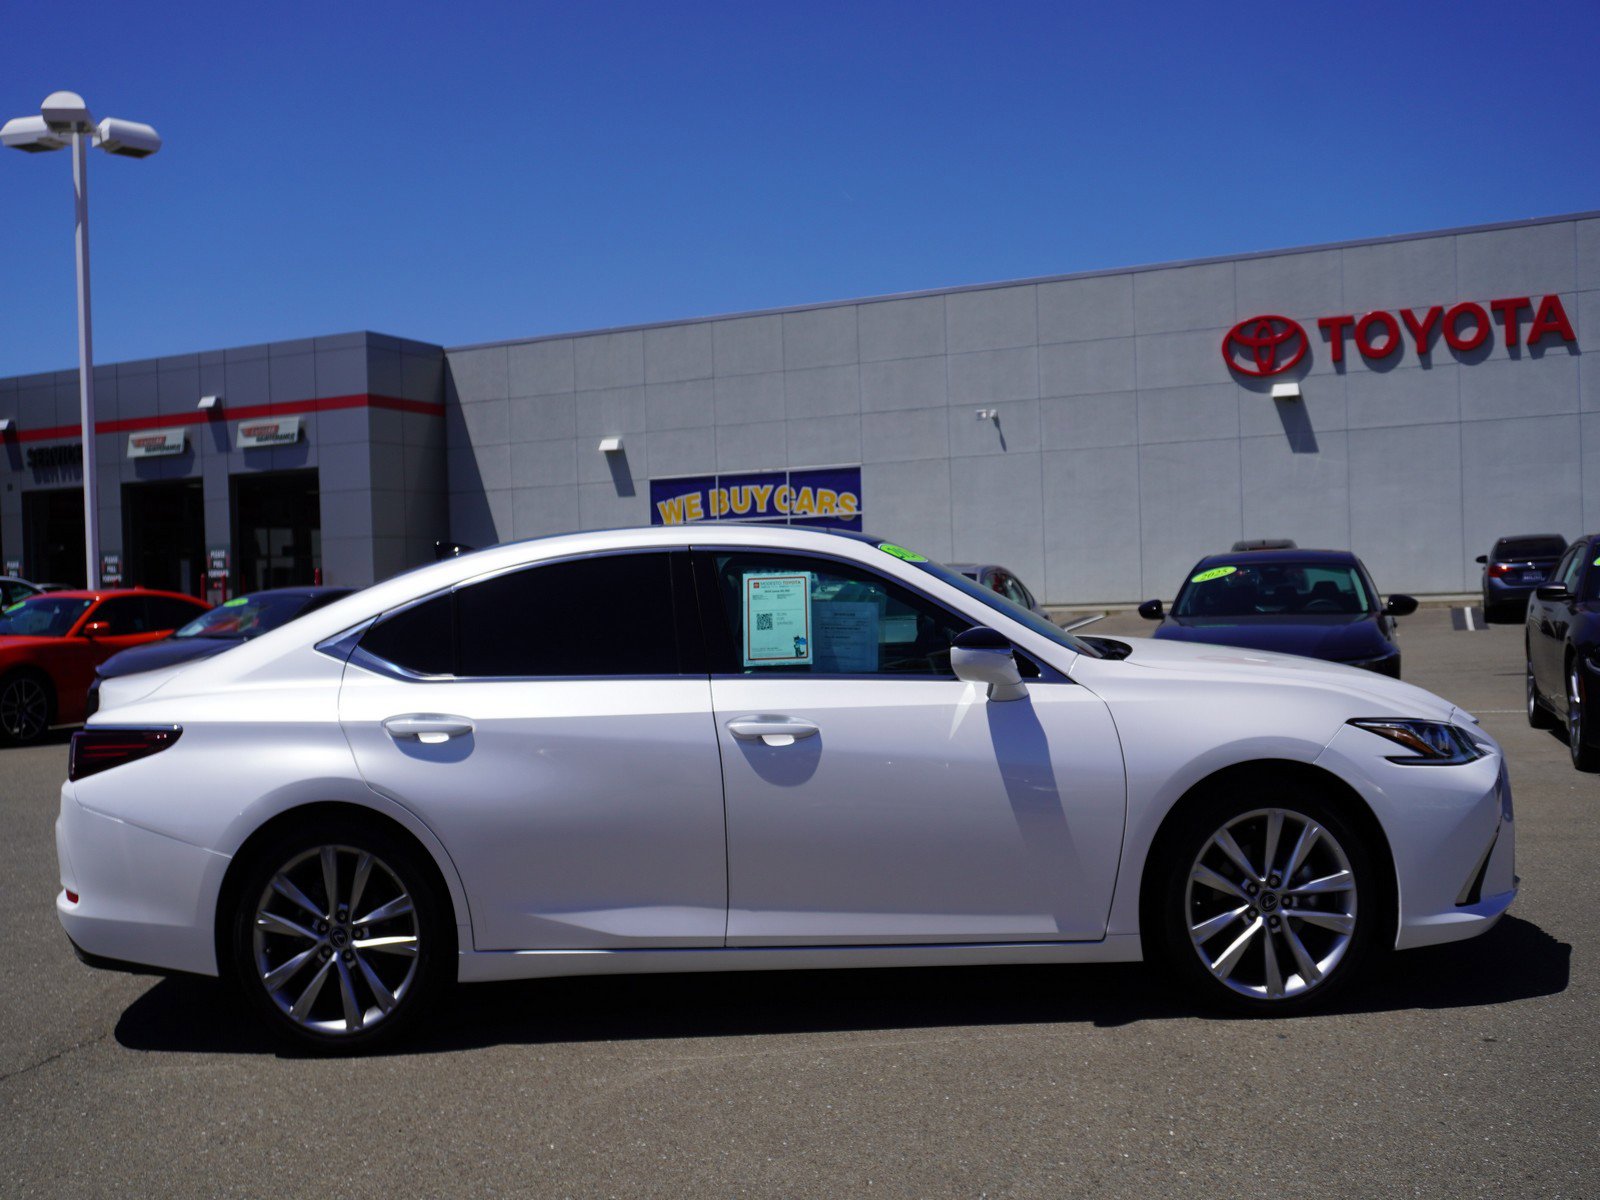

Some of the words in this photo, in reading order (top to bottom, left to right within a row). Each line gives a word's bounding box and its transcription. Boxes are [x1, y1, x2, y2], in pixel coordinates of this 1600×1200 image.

[1318, 294, 1577, 362] TOYOTA
[657, 491, 704, 525] WE
[709, 485, 773, 517] BUY
[774, 484, 858, 521] CARS
